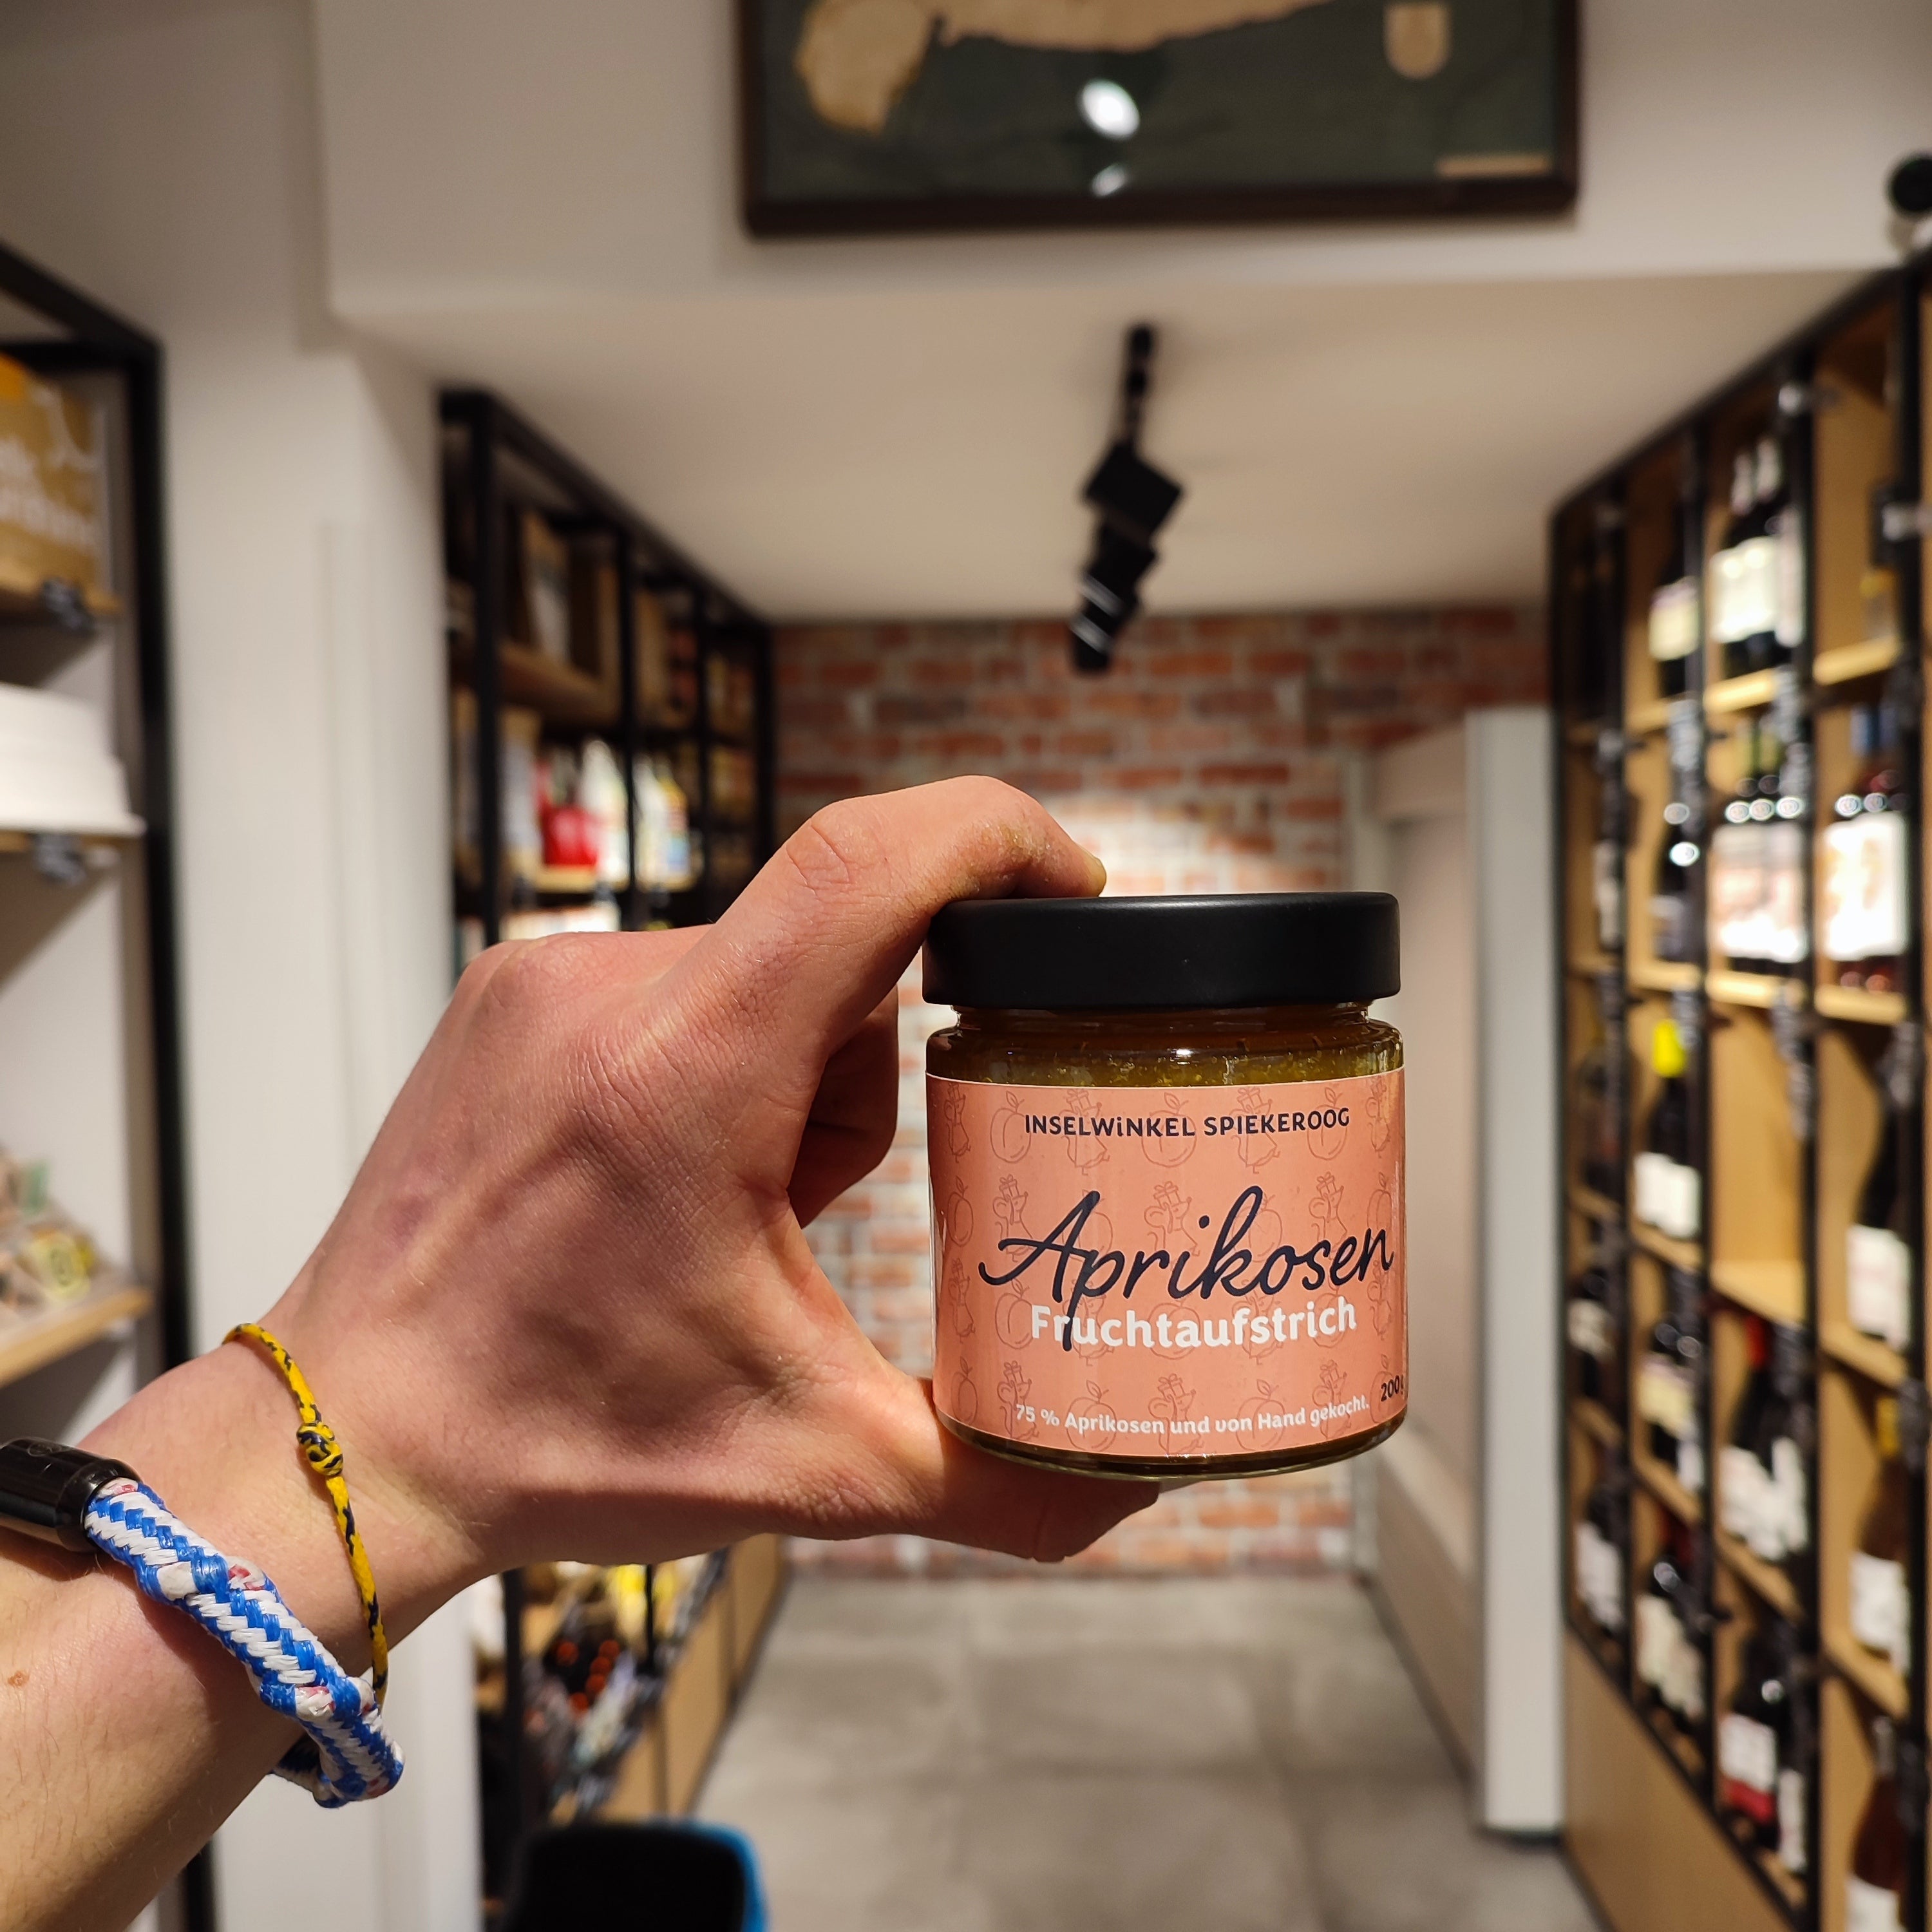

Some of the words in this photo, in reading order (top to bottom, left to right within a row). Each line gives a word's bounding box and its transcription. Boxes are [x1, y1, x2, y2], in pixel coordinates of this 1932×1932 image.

[1204, 1107, 1350, 1136] SPIEKEROOG
[978, 1185, 1394, 1352] Aprikosen
[1031, 1296, 1357, 1348] Fruchtaufstrich
[1016, 1404, 1036, 1423] 75
[1040, 1408, 1060, 1426] %
[1065, 1412, 1165, 1435] Aprikosen
[1170, 1416, 1211, 1434] und
[1215, 1416, 1253, 1433] von
[1258, 1407, 1307, 1430] Hand
[1310, 1394, 1370, 1428] gekocht.
